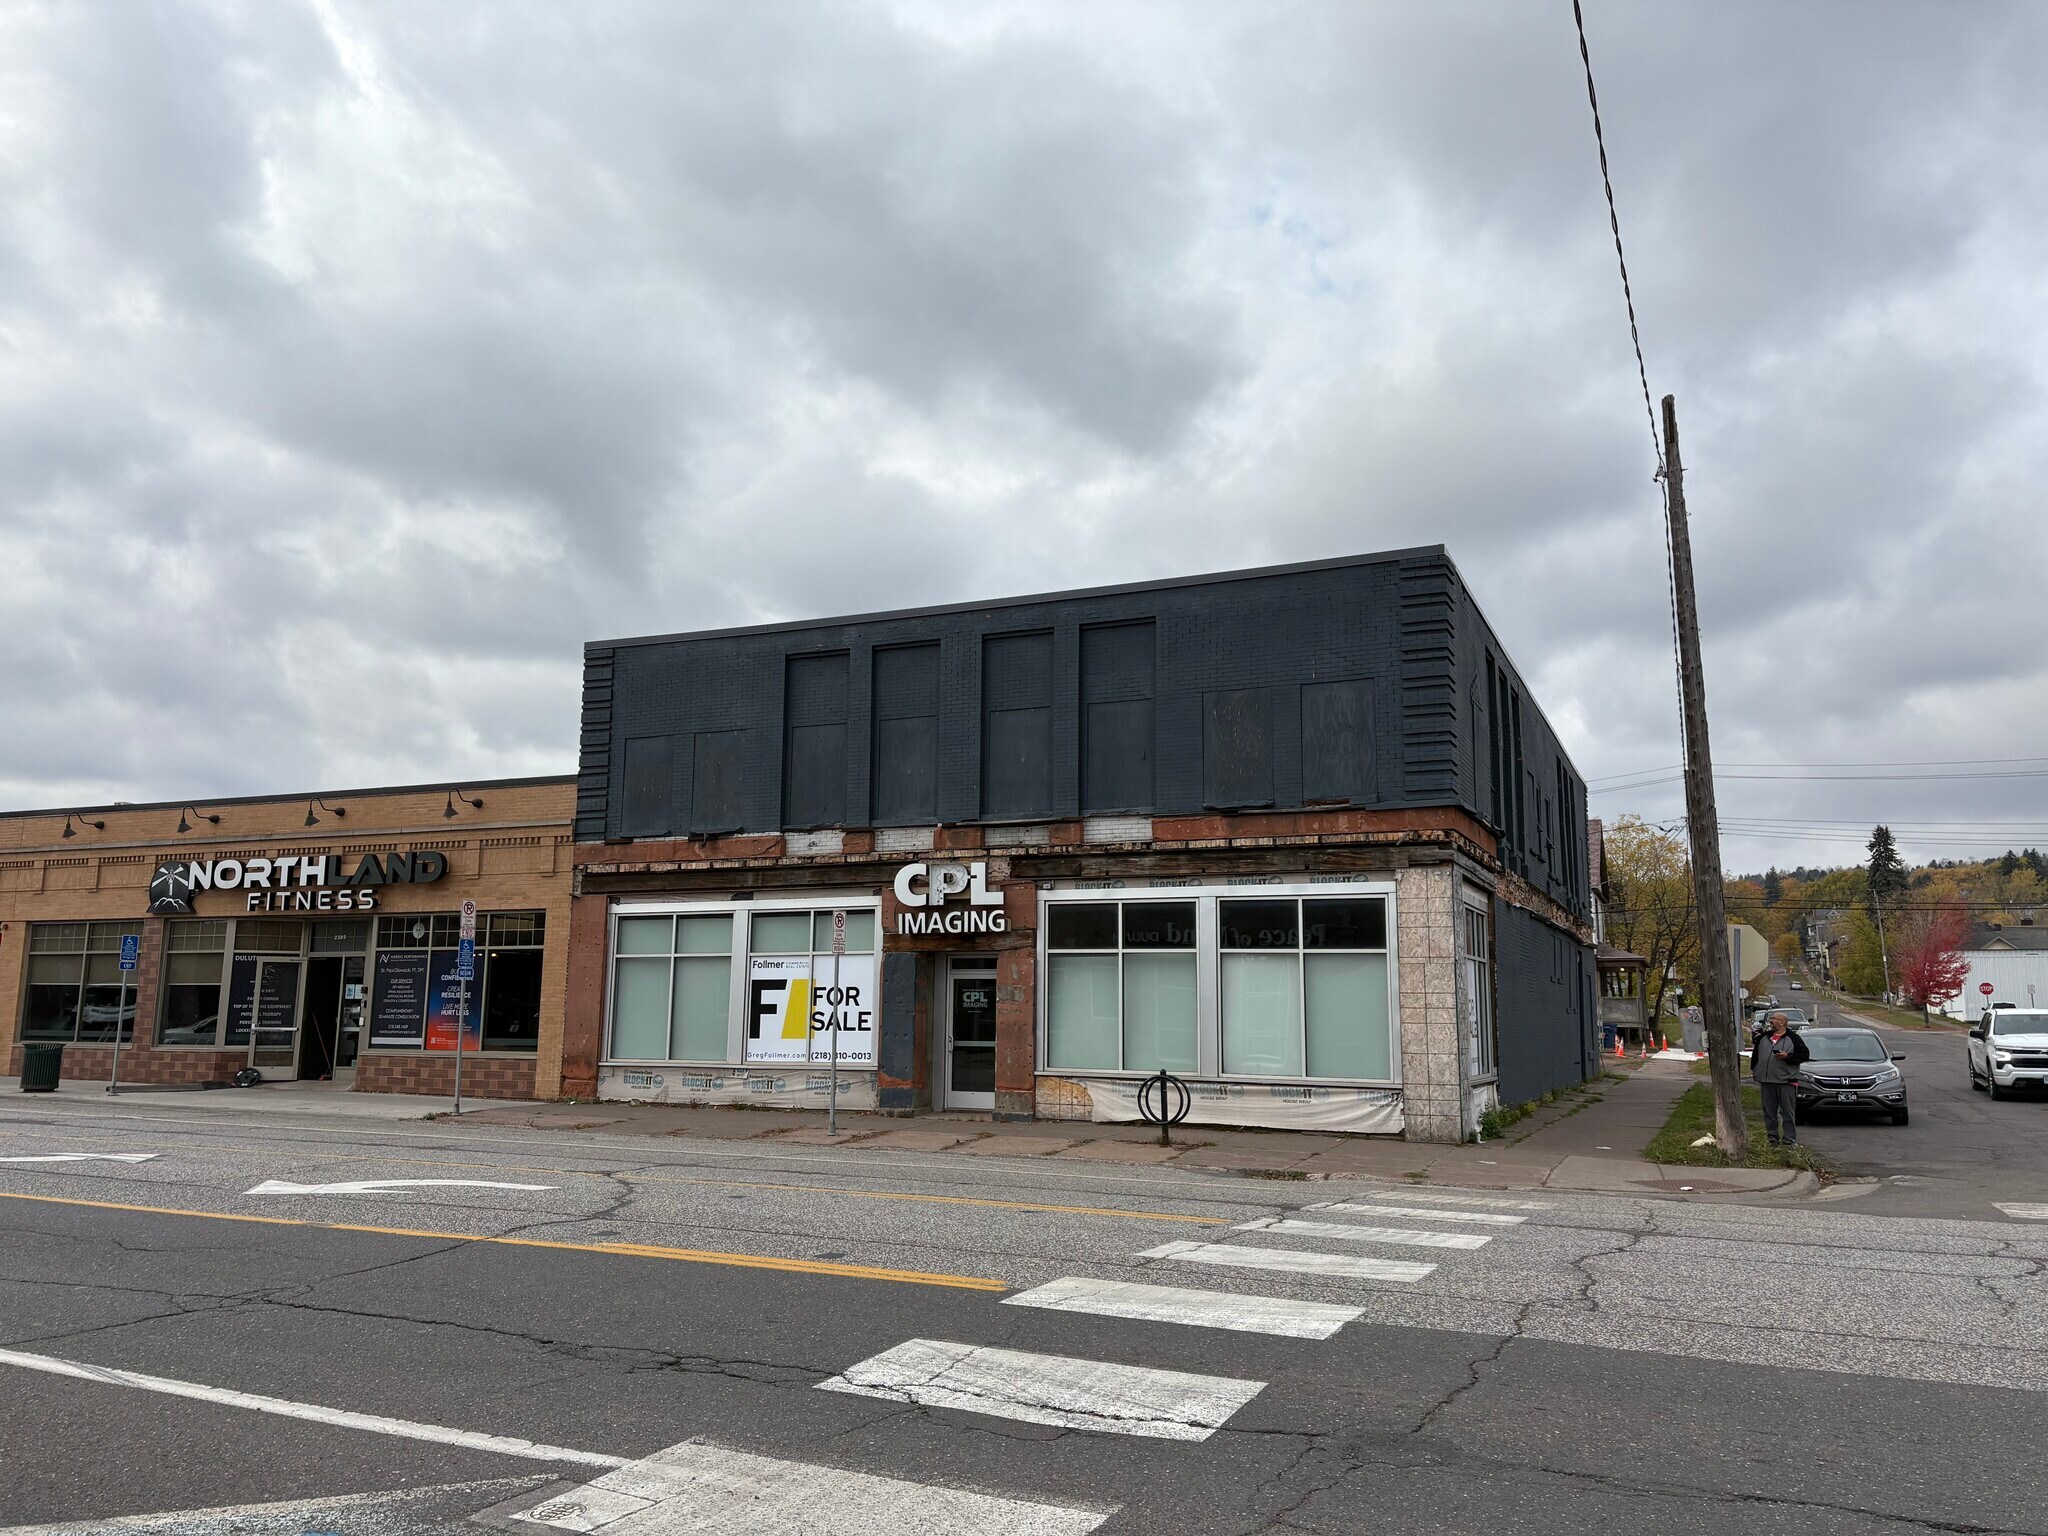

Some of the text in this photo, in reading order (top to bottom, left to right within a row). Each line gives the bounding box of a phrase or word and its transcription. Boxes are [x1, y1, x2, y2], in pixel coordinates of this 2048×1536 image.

[188, 851, 448, 890] NORTHLAND
[893, 862, 1004, 907] CPL
[246, 889, 374, 912] FITNESS
[898, 910, 1006, 934] IMAGING
[752, 960, 784, 969] Follmer
[813, 986, 860, 1006] FOR
[962, 992, 988, 1002] CPL
[811, 1011, 872, 1031] SALE
[811, 1052, 831, 1060] (218)
